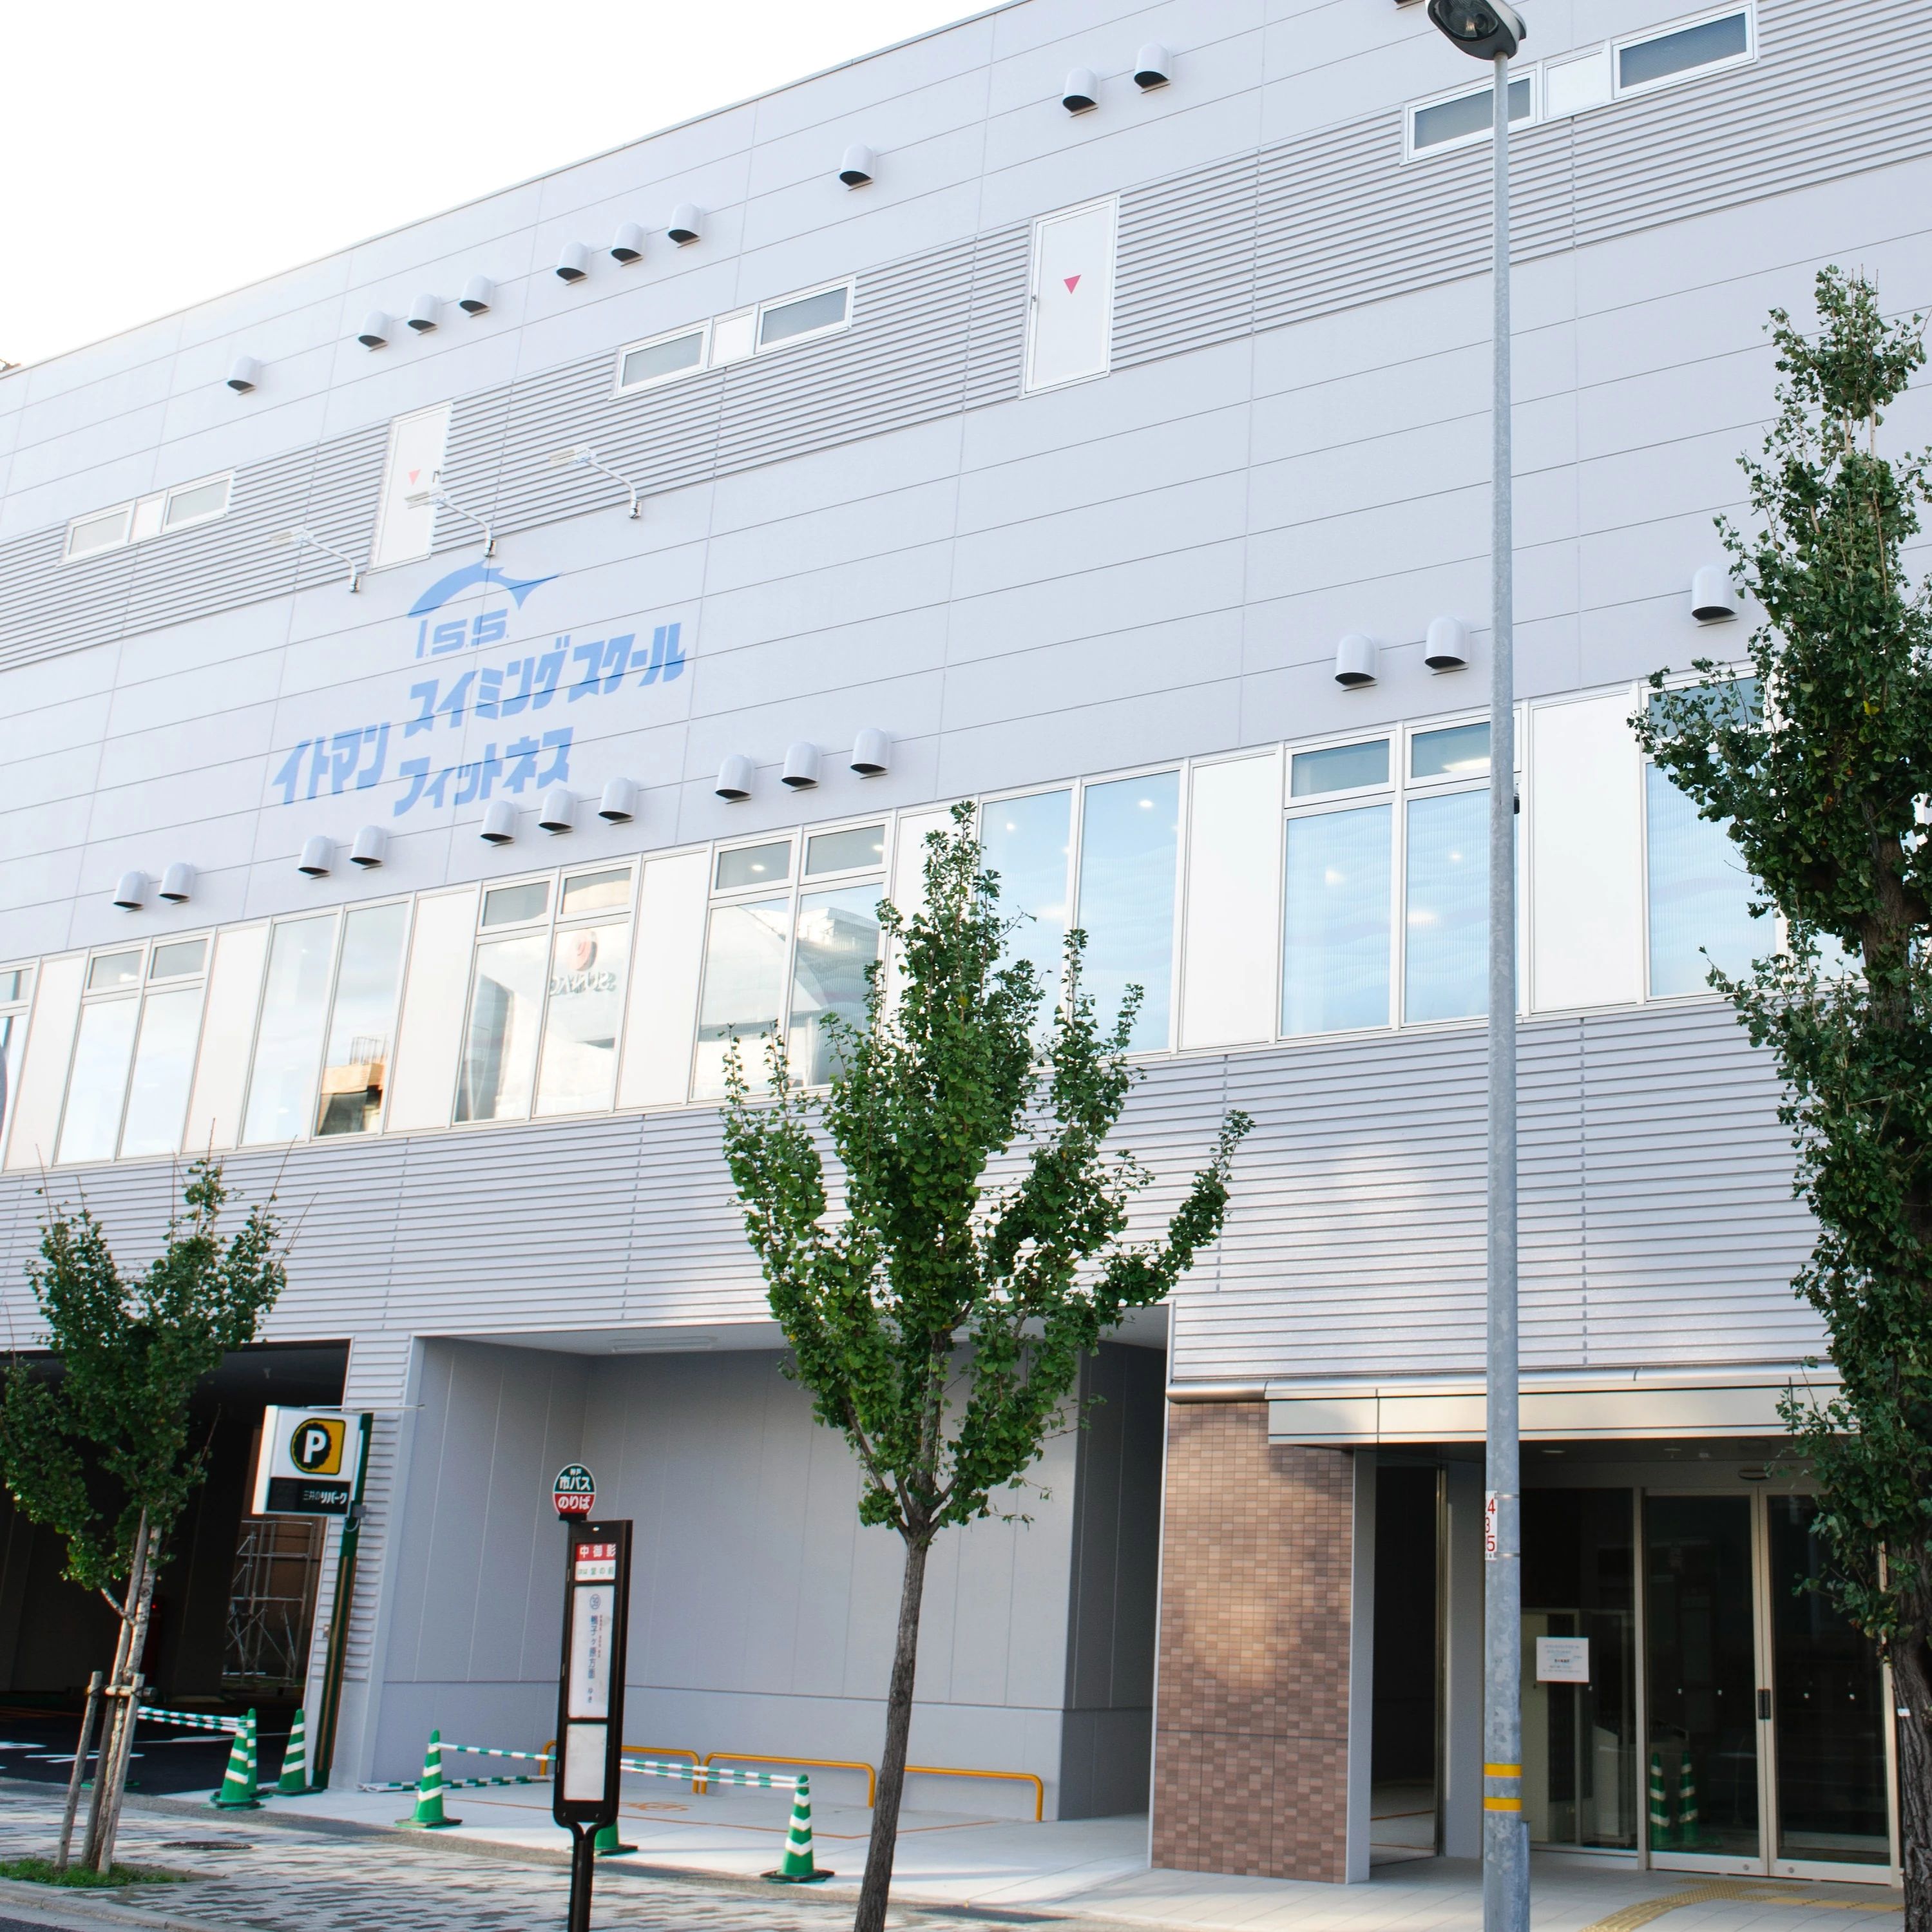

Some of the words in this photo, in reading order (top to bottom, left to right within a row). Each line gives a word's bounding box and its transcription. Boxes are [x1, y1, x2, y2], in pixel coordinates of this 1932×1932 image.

[271, 722, 392, 805] イトマン
[394, 727, 574, 816] フィットネス
[303, 1430, 327, 1463] P
[559, 1475, 591, 1491] 市バス
[558, 1495, 591, 1509] のりば
